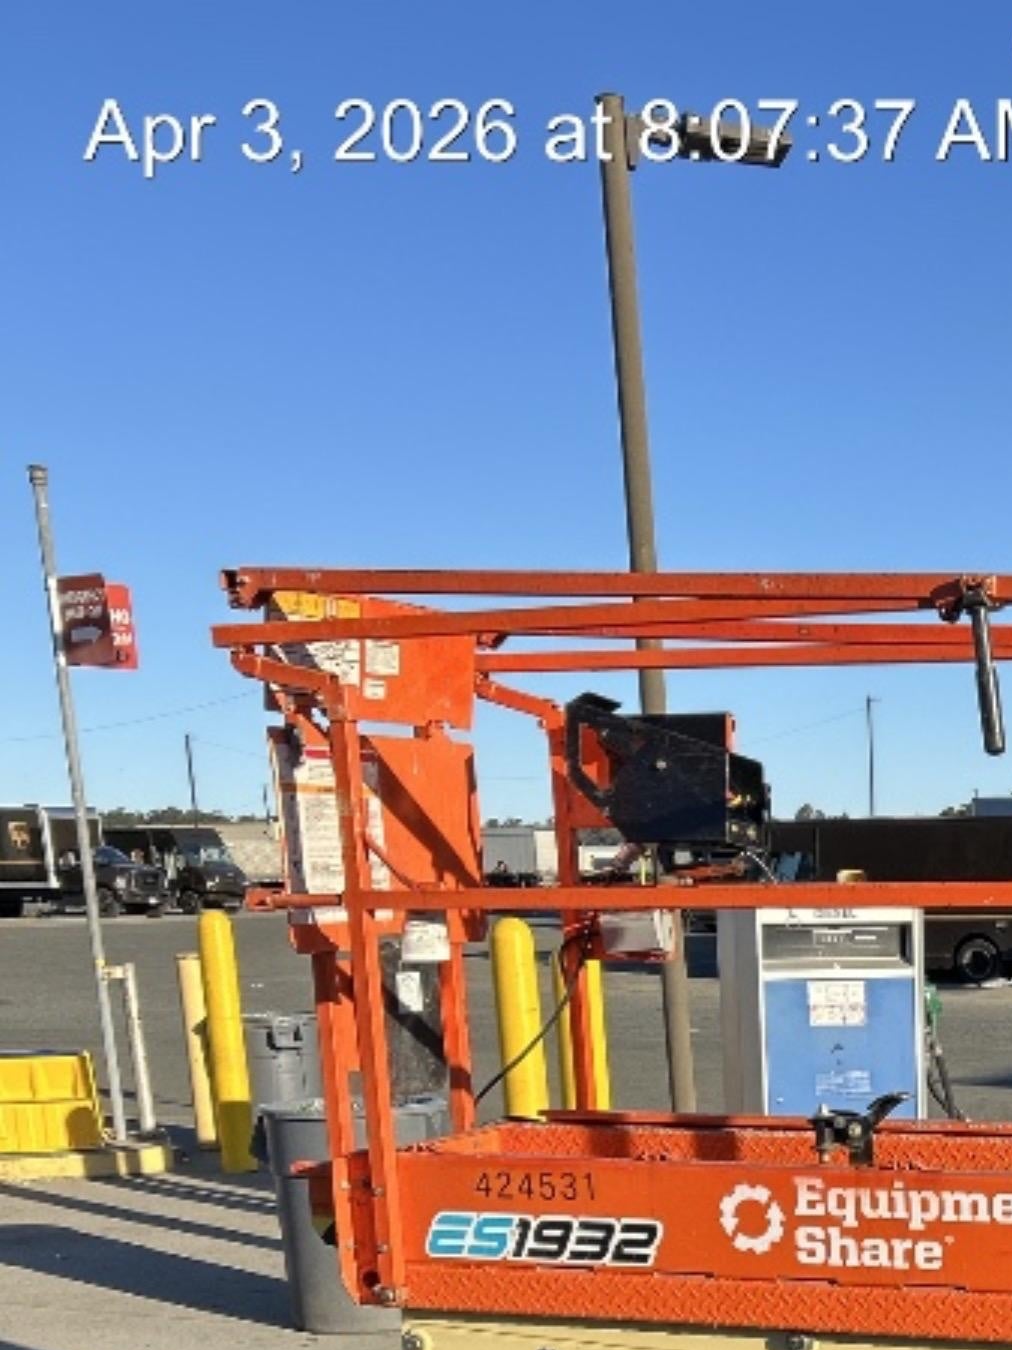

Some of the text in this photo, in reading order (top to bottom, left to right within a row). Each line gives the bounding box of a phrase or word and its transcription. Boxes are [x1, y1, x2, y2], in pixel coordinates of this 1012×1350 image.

[475, 1172, 597, 1201] 424531
[426, 1211, 664, 1267] ES1932
[794, 1226, 944, 1270] Share
